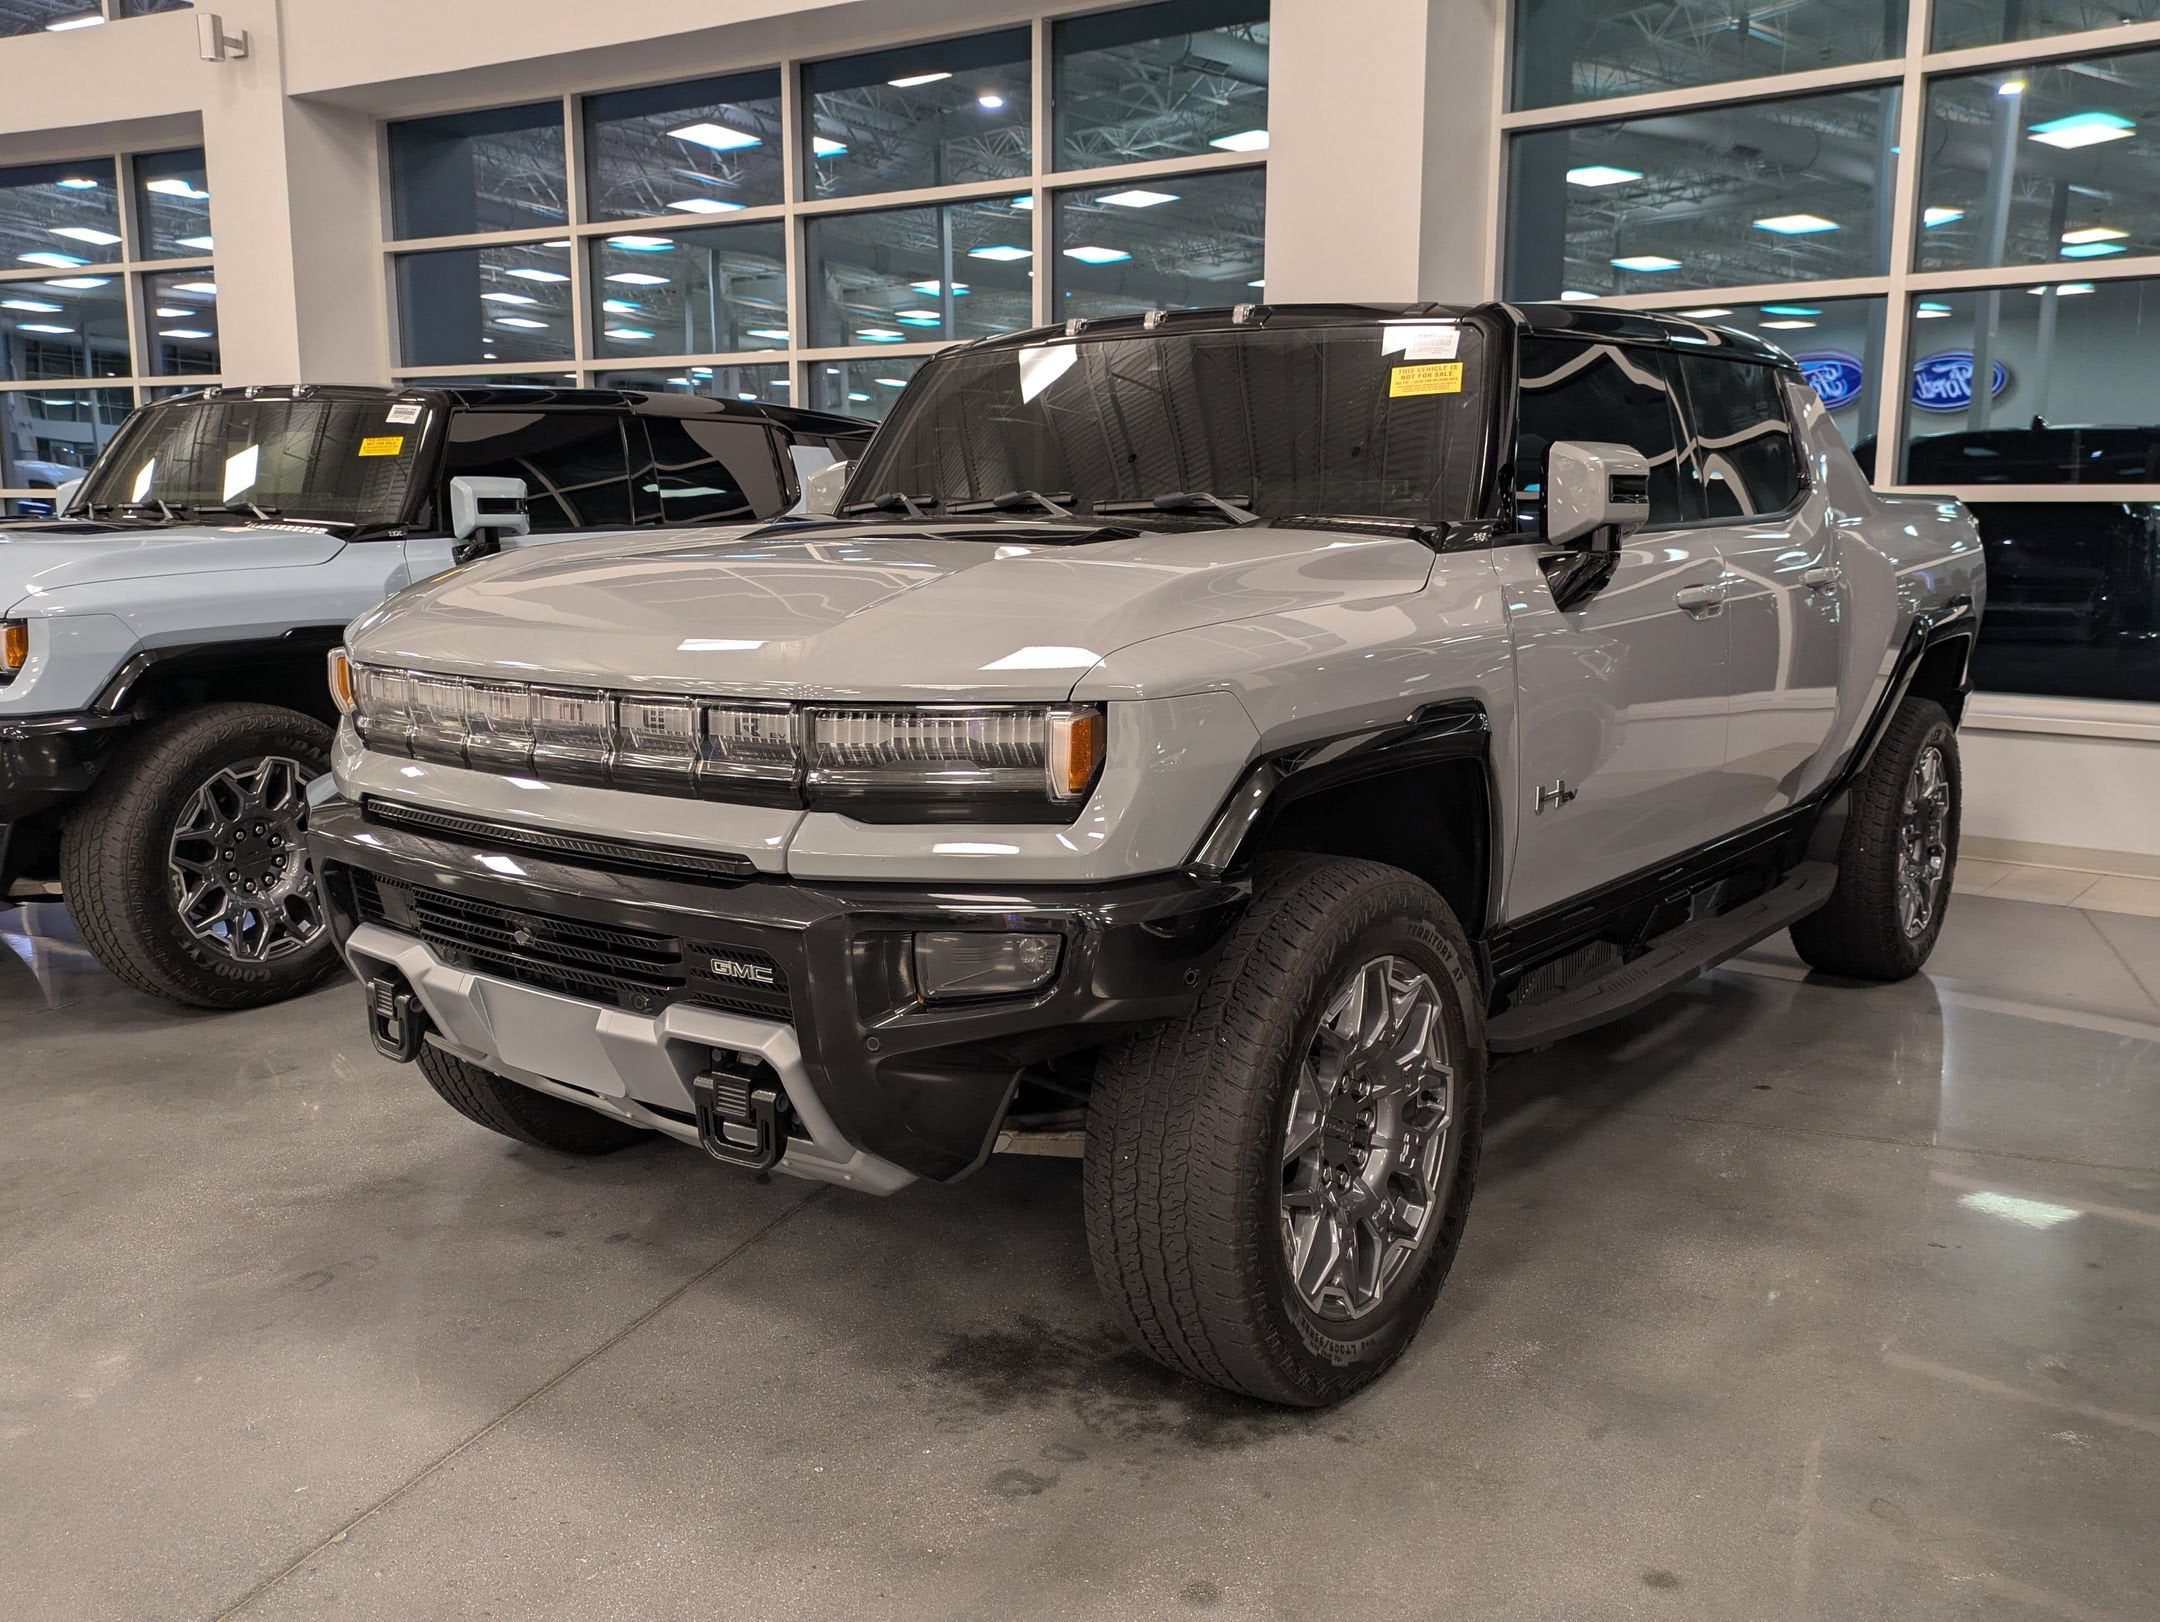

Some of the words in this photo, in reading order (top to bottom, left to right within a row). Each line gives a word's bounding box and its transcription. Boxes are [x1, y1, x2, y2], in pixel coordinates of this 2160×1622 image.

[1417, 365, 1448, 373] VEHICLE
[170, 921, 271, 982] GOODYEA
[710, 958, 774, 984] GMC
[1407, 923, 1454, 962] TERRITORY
[1452, 967, 1464, 982] AT
